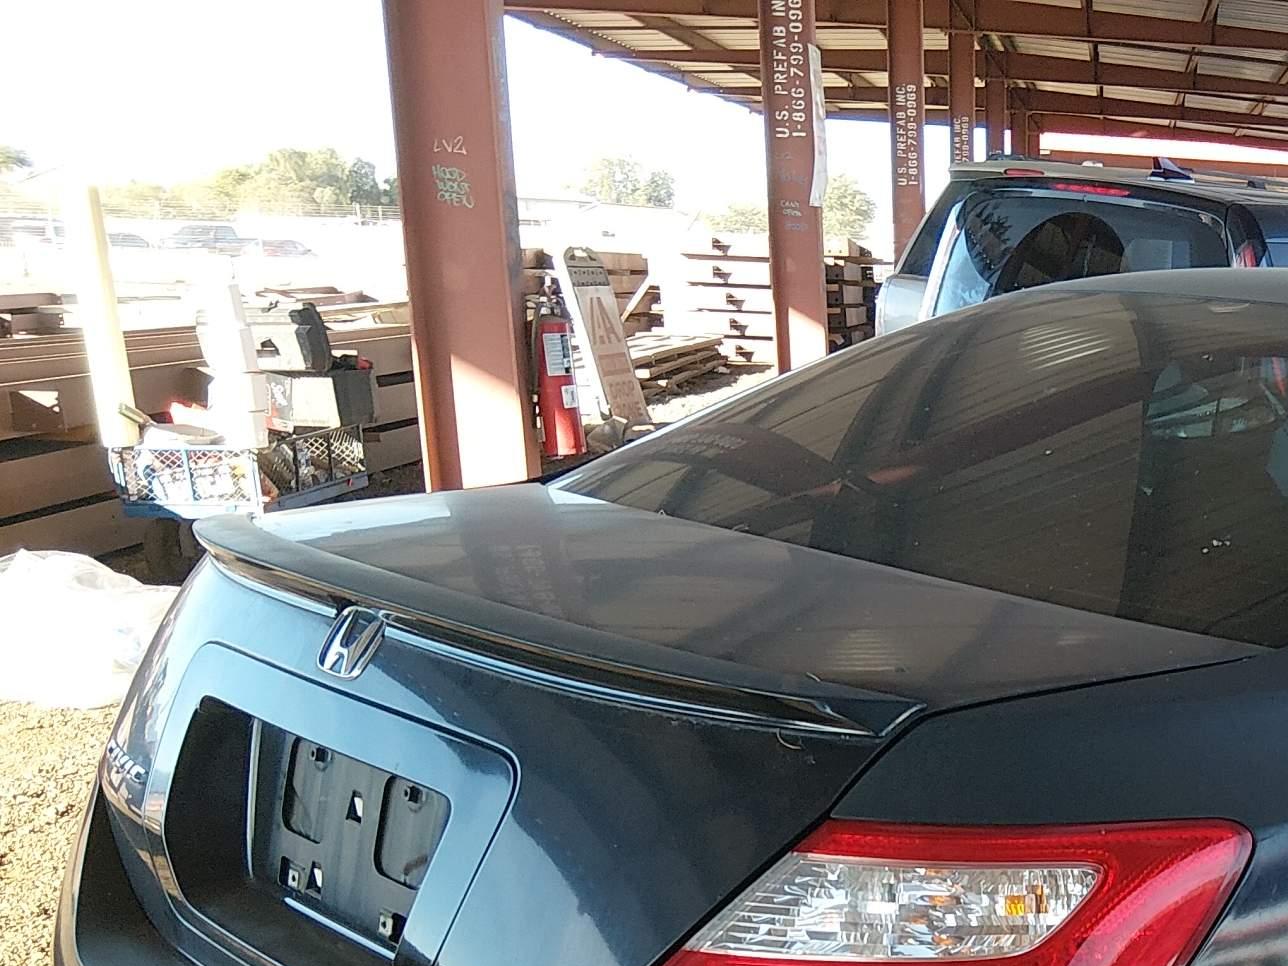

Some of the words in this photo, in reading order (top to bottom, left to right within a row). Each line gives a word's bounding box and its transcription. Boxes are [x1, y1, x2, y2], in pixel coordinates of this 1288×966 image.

[772, 25, 789, 95] PREFAB
[775, 105, 790, 138] U.S.
[896, 111, 907, 158] PREFAB
